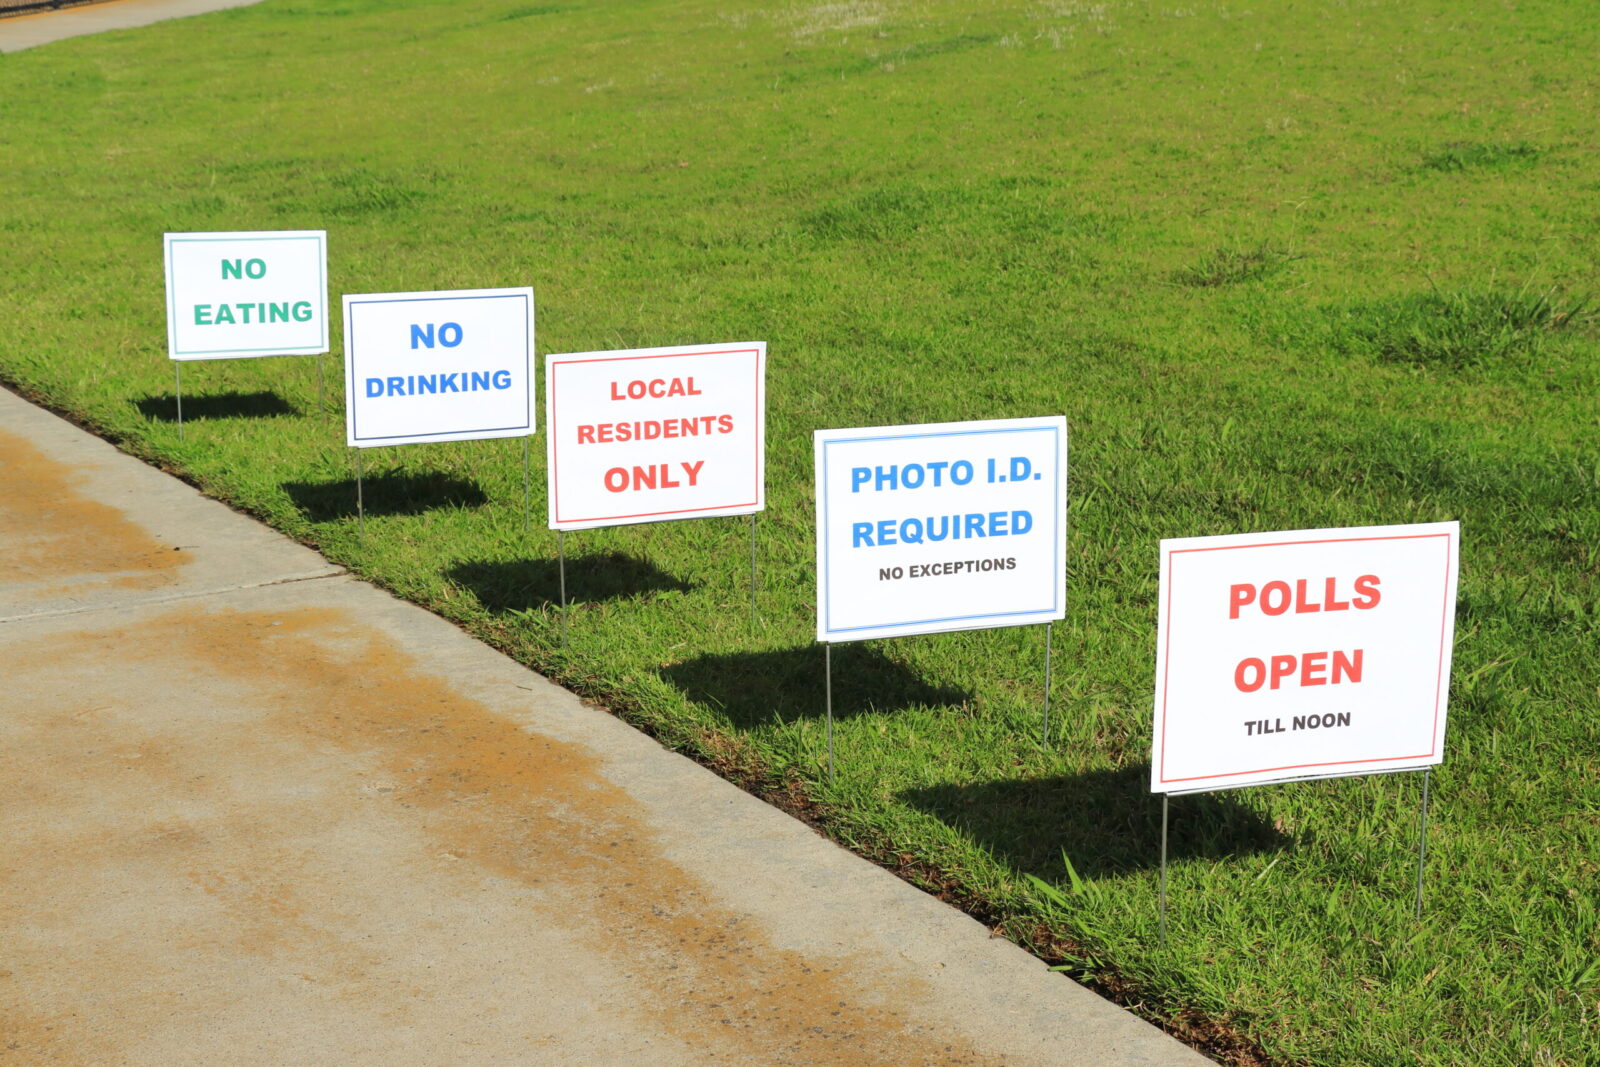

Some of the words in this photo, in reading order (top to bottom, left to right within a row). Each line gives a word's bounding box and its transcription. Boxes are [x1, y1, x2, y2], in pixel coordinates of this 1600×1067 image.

[221, 257, 267, 280] NO
[193, 300, 313, 326] EATING
[410, 321, 464, 350] NO
[365, 369, 512, 399] DRINKING
[610, 376, 702, 401] LOCAL
[577, 414, 734, 445] RESIDENTS
[603, 460, 705, 493] ONLY
[851, 459, 974, 494] PHOTO
[987, 456, 1042, 484] I.D.
[852, 510, 1033, 548] REQUIRED
[879, 566, 904, 581] NO
[909, 557, 1017, 578] EXCEPTIONS
[1229, 574, 1381, 620] POLLS
[1234, 649, 1364, 693] OPEN
[1244, 718, 1286, 736] TILL
[1292, 711, 1351, 731] NOON
